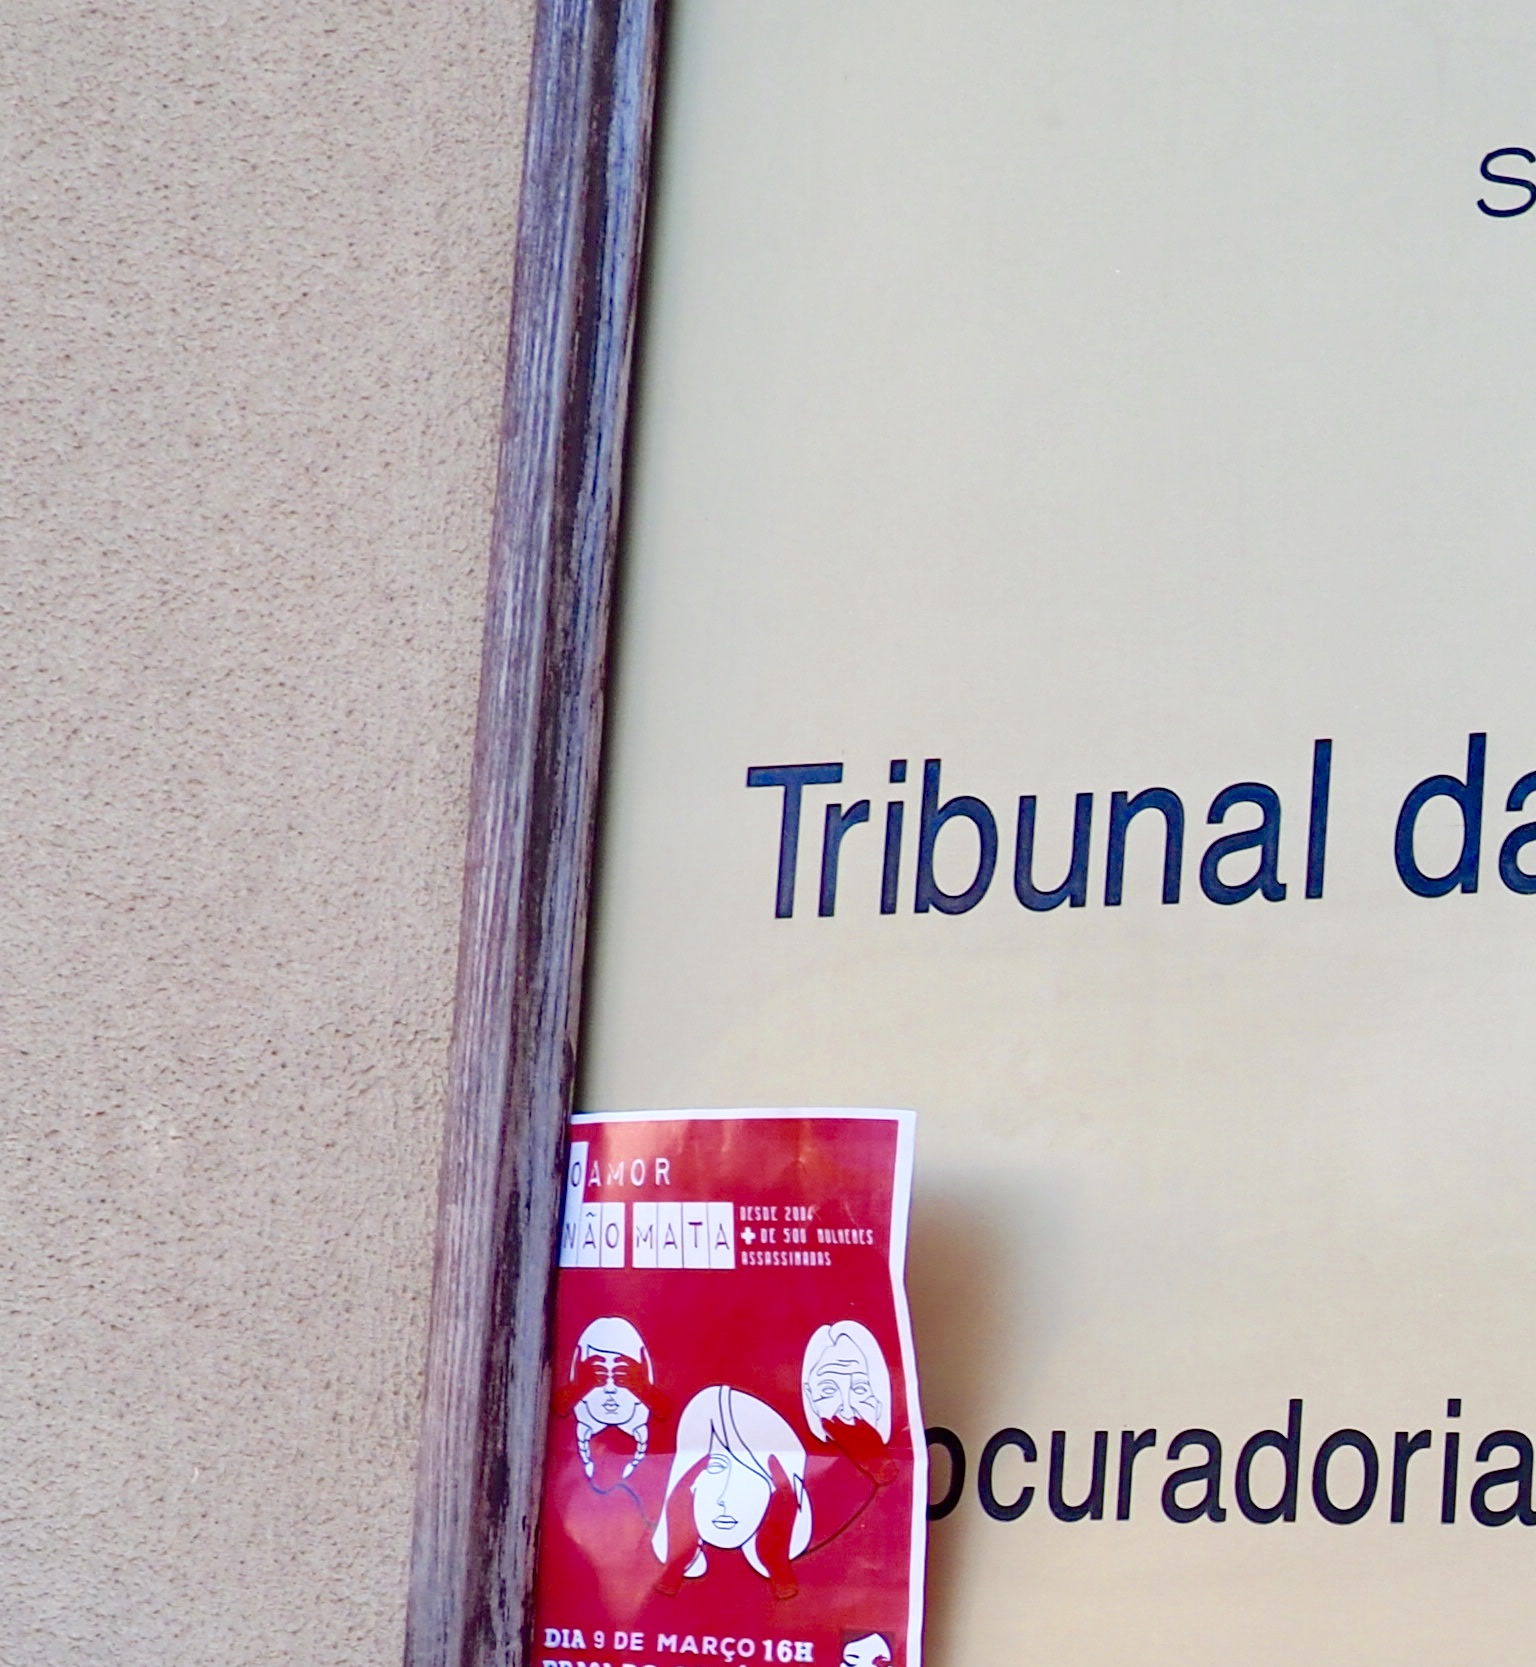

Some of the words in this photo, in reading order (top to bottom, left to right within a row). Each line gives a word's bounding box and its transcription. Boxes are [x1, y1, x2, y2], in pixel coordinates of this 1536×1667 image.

[746, 738, 1333, 919] Tribunal
[588, 1157, 671, 1187] AMOR
[560, 1211, 621, 1249] NÃO
[635, 1221, 730, 1250] MATA
[760, 1227, 777, 1244] DE
[926, 1398, 1536, 1527] ocuradoria
[544, 1627, 586, 1650] DIA
[593, 1630, 605, 1650] 9
[613, 1631, 645, 1652] DE
[656, 1633, 756, 1663] MARÇO
[763, 1639, 815, 1664] 16H
